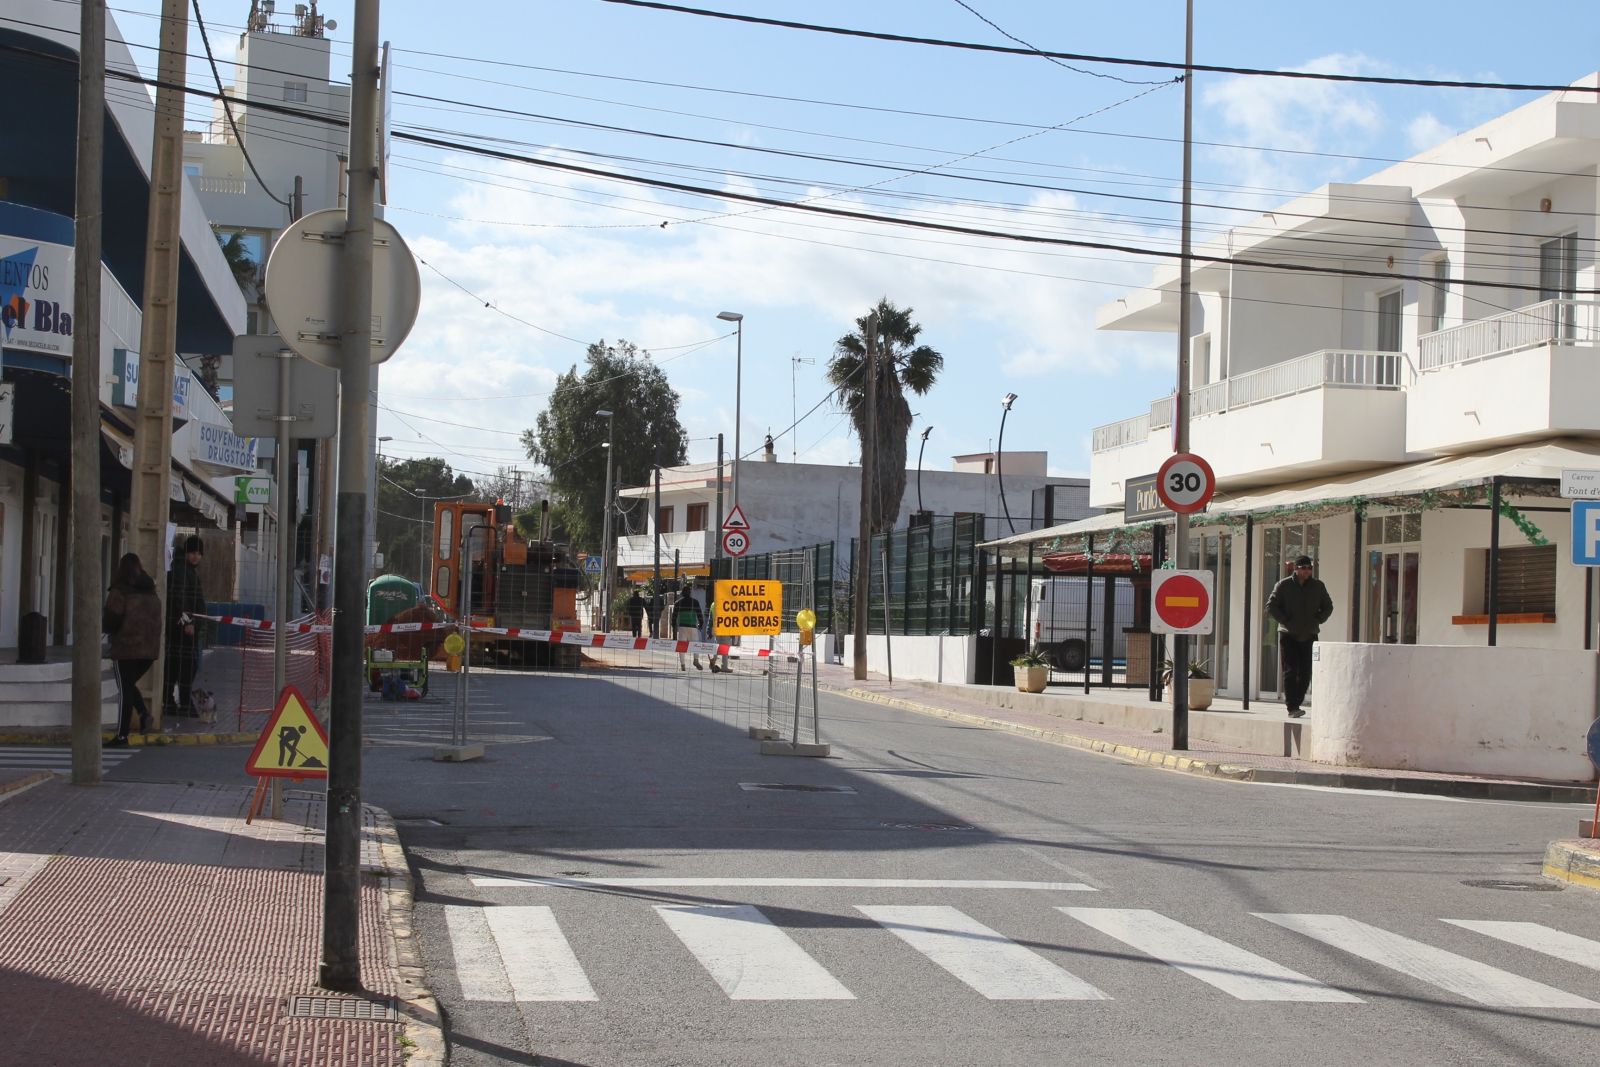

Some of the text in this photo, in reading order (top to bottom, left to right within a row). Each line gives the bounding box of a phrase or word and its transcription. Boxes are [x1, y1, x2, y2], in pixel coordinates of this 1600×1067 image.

[0, 258, 49, 291] ENTOS
[200, 425, 245, 449] SOUVENIRS
[208, 445, 255, 468] DRUGSTORE
[1170, 473, 1201, 492] 30
[1571, 473, 1595, 481] Carrer
[247, 487, 269, 496] ATM
[1568, 487, 1588, 495] Font
[1136, 485, 1158, 512] Punto
[729, 538, 743, 547] 30
[731, 585, 765, 596] CALLE
[722, 601, 774, 611] CORTADA
[716, 616, 779, 628] POR OBRAS
